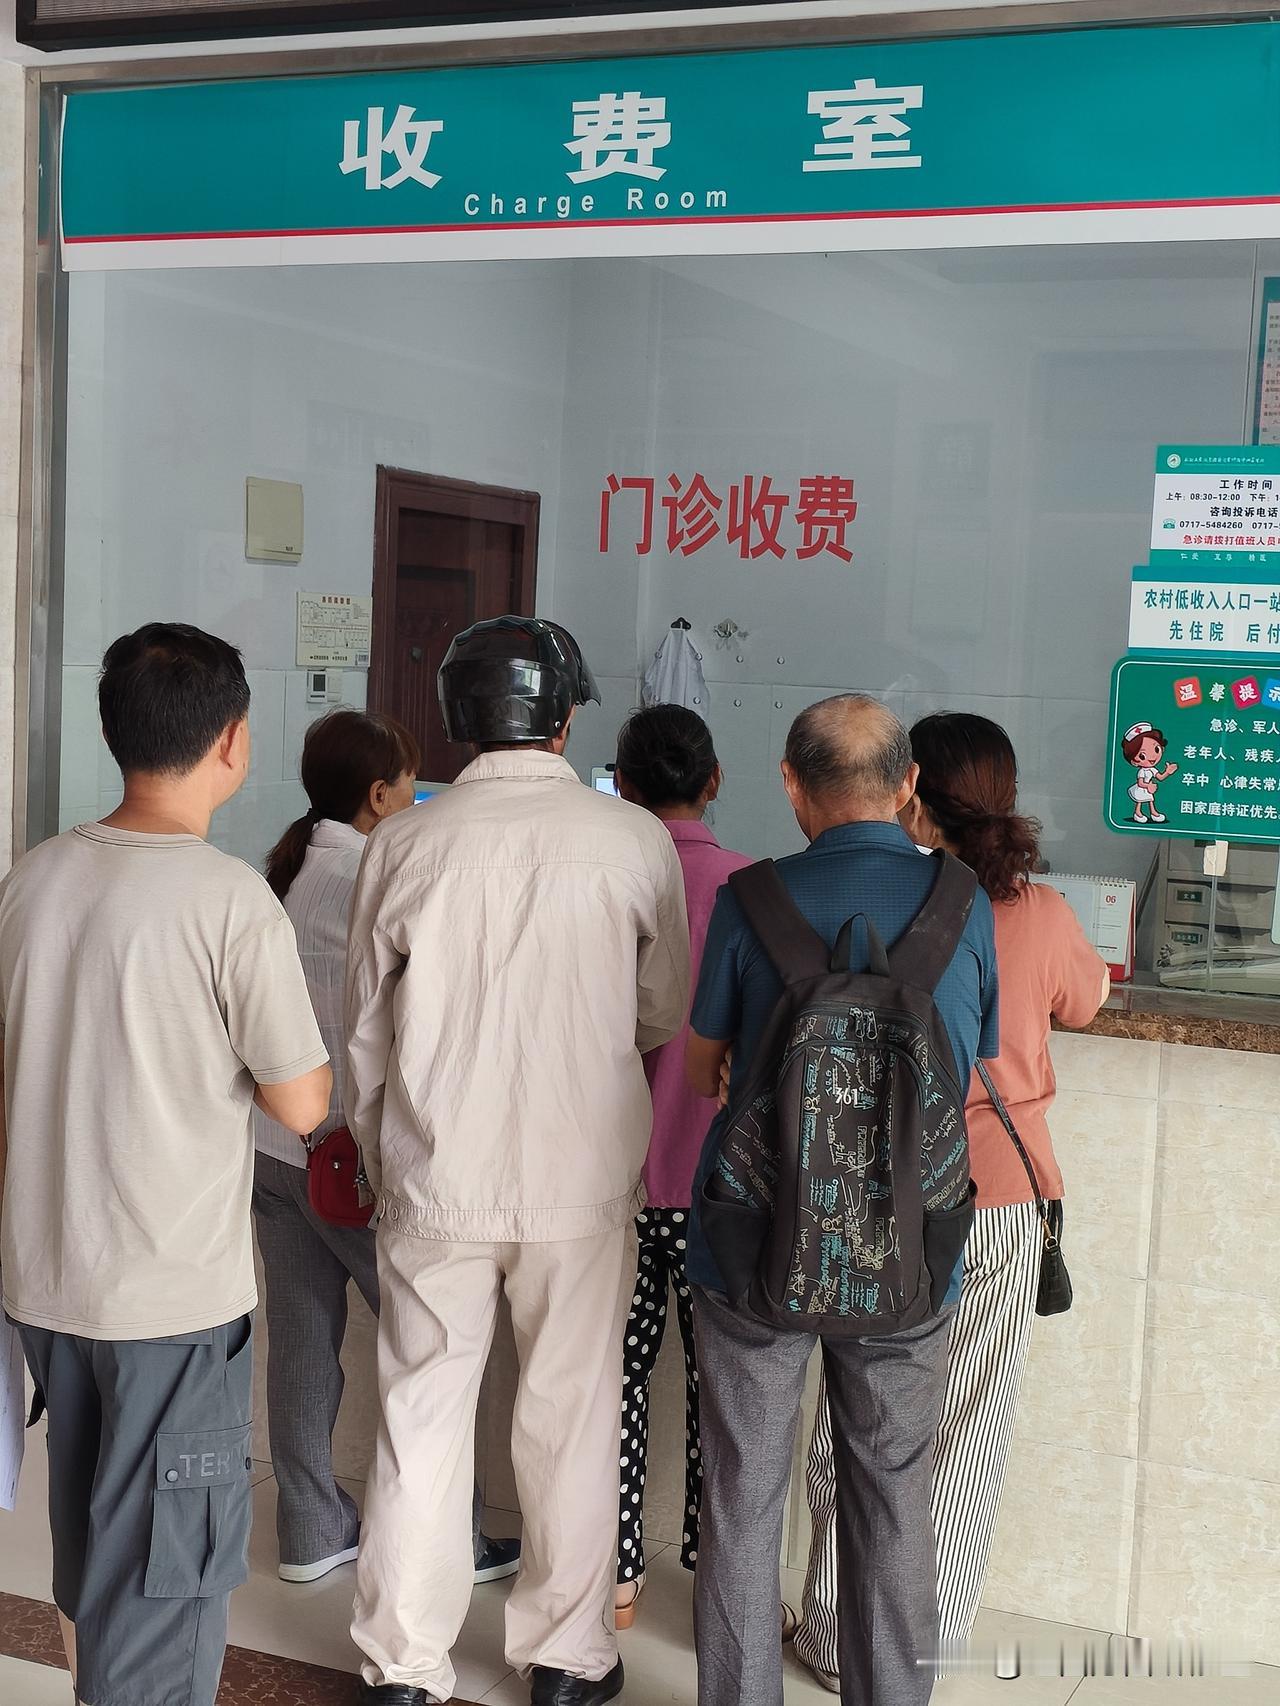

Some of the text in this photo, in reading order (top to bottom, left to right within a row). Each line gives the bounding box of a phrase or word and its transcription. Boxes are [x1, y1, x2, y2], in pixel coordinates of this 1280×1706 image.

[338, 78, 924, 191] 收费室
[464, 187, 728, 219] Charge Room
[1219, 479, 1273, 491] 工作时间
[599, 472, 858, 563] 门诊收费
[1210, 506, 1279, 518] 咨询投诉电话
[1179, 520, 1280, 530] 0717-5484260 0717-
[1183, 534, 1280, 546] 急诊请拨打值班人员
[1169, 620, 1224, 642] 先住院
[1184, 745, 1280, 763] 老年人、残疾
[1220, 775, 1280, 792] 心律失常
[1105, 895, 1117, 904] 06
